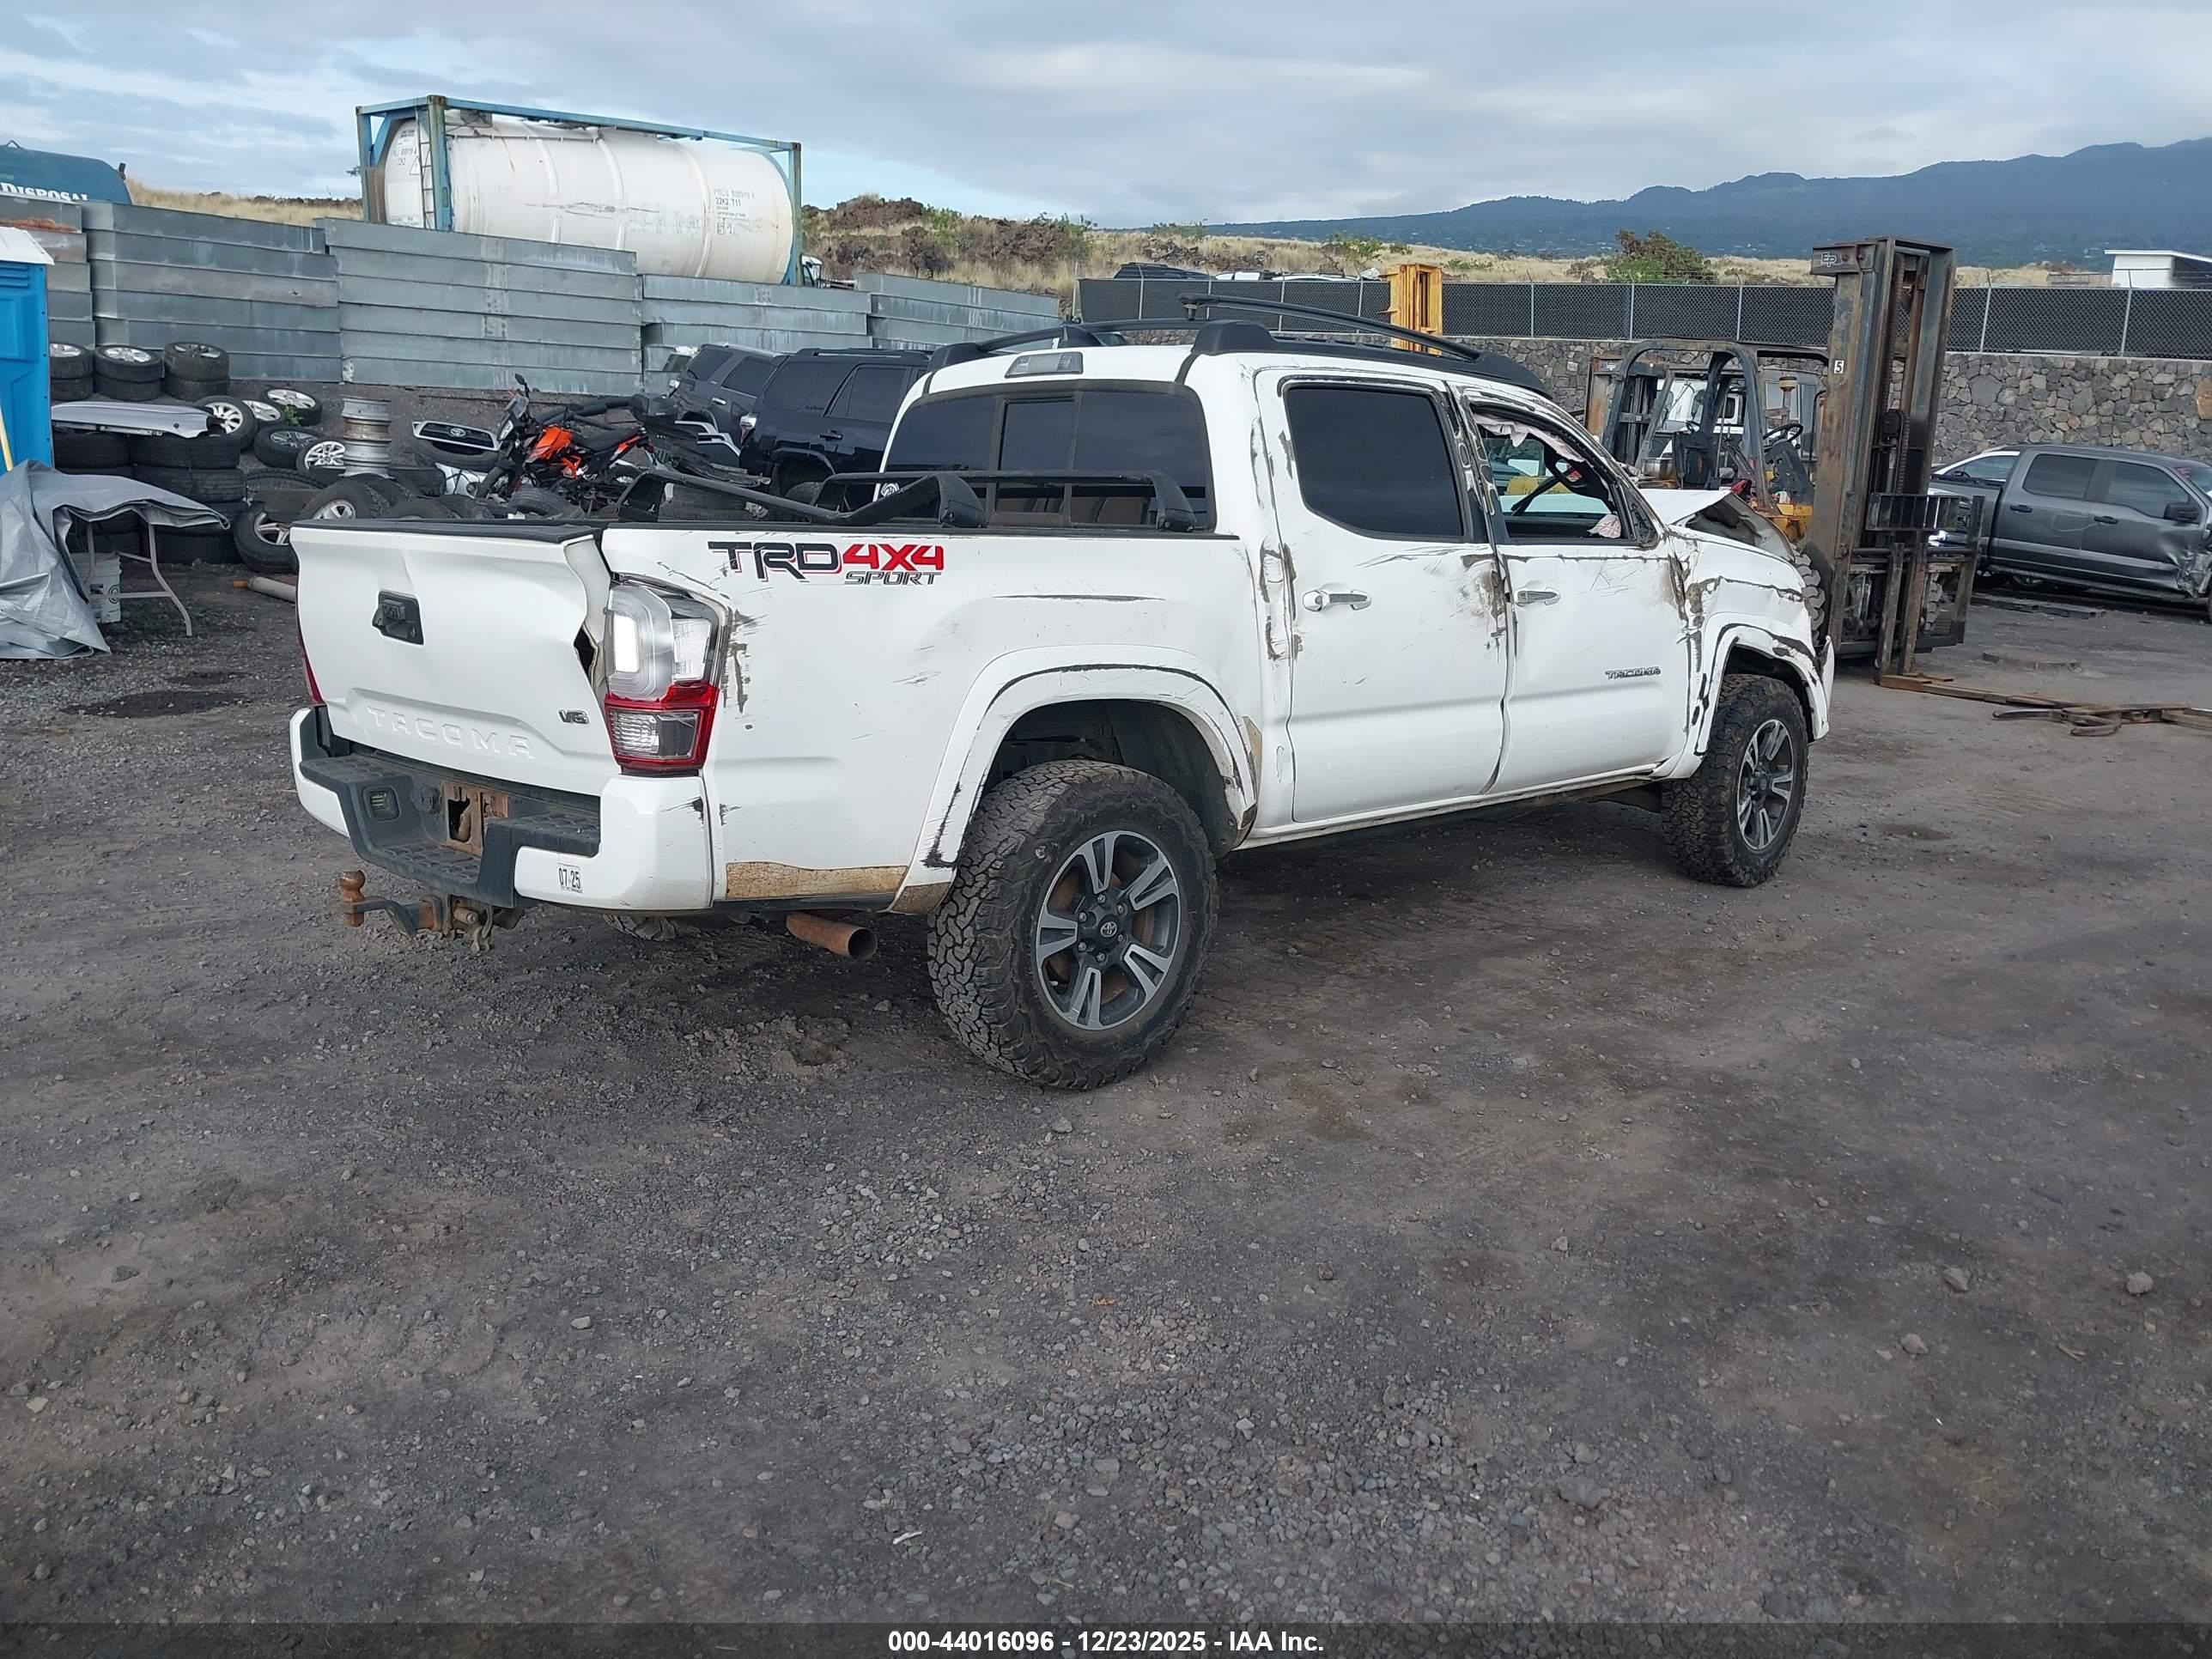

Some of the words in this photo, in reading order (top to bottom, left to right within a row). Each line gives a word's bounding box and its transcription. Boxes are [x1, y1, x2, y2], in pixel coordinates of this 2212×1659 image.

[1835, 361, 1843, 373] 5
[708, 541, 842, 583] TRD
[844, 570, 941, 586] SPORT
[1605, 666, 1662, 680] TACOMA
[558, 709, 590, 725] V6
[366, 706, 536, 760] TACOMA
